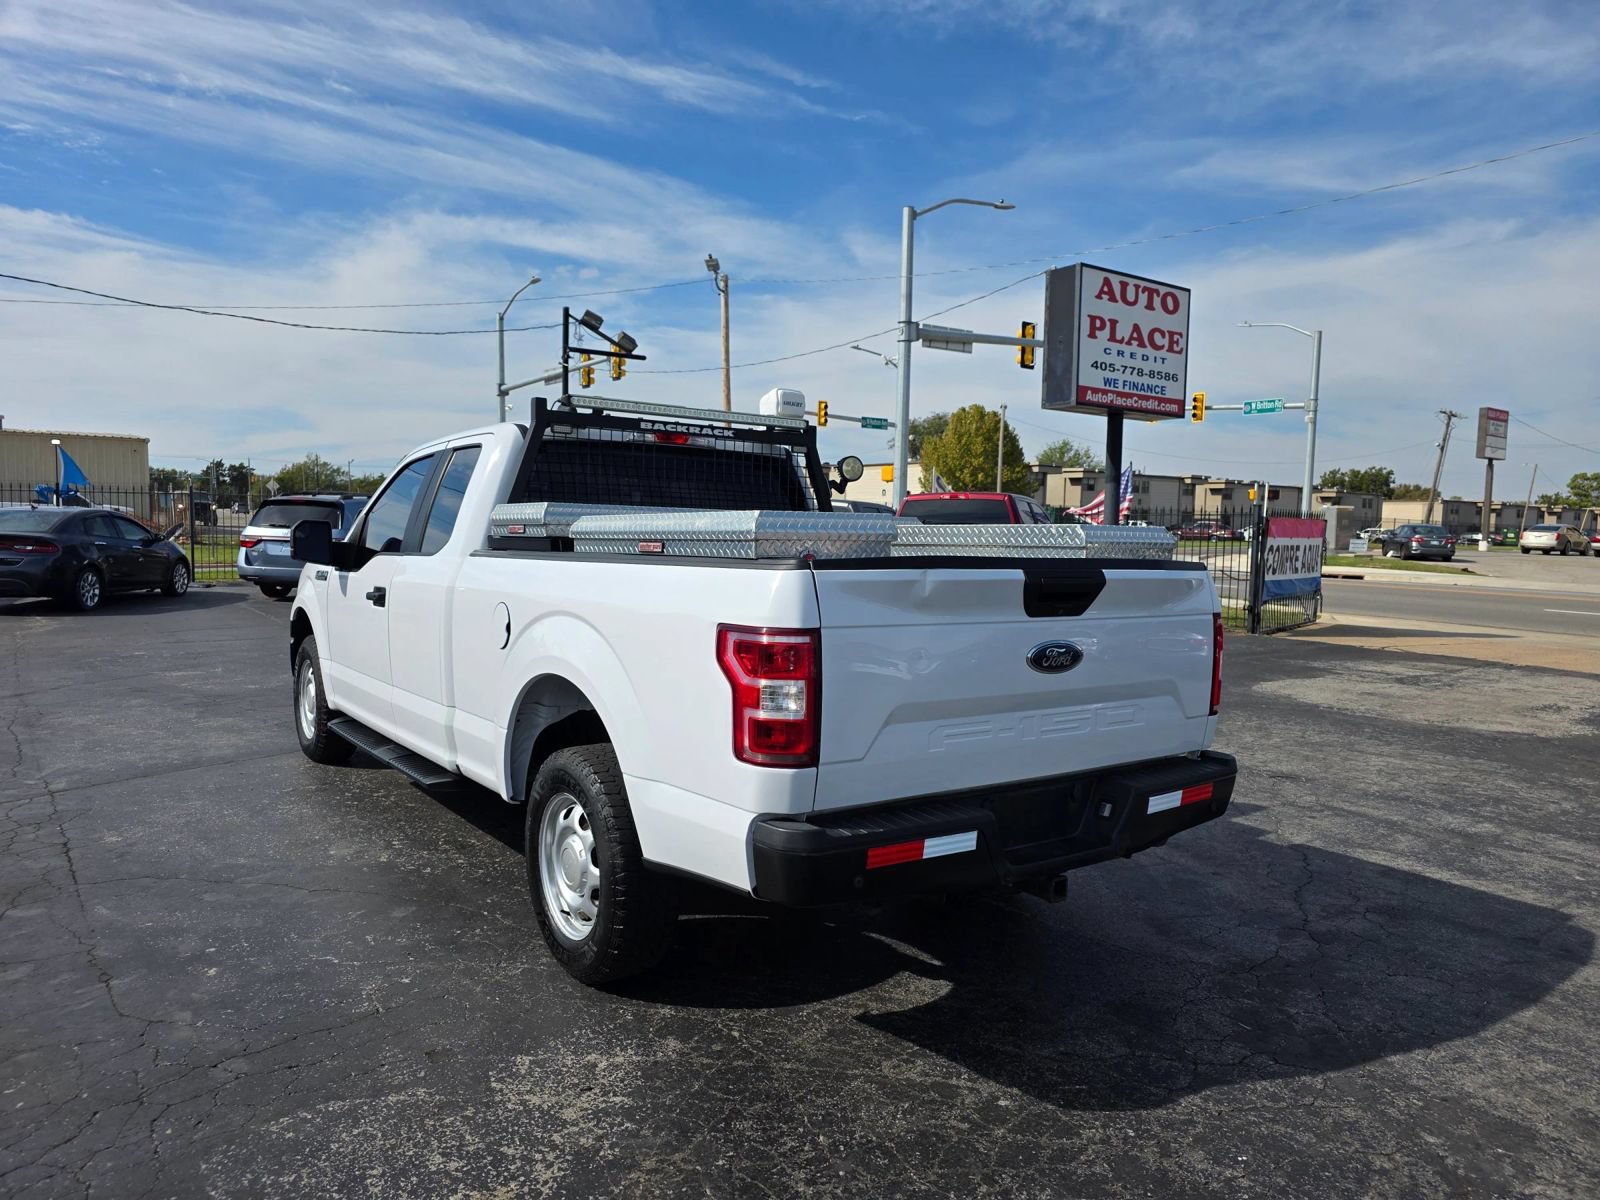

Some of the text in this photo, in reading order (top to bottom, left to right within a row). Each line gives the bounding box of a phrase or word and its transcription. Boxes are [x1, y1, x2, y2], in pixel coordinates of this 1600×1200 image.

[1095, 276, 1180, 315] AUTO
[1087, 314, 1184, 355] PLACE
[1103, 347, 1168, 365] CREDIT
[1090, 360, 1179, 383] 405-778-8586
[1103, 376, 1167, 396] WE FINANCE
[1086, 390, 1178, 412] AutoPlaceCredit.com
[640, 421, 735, 437] BACKRACK
[1266, 544, 1300, 576] COMPRE
[1042, 647, 1074, 667] Ford
[928, 703, 1145, 752] F-150
